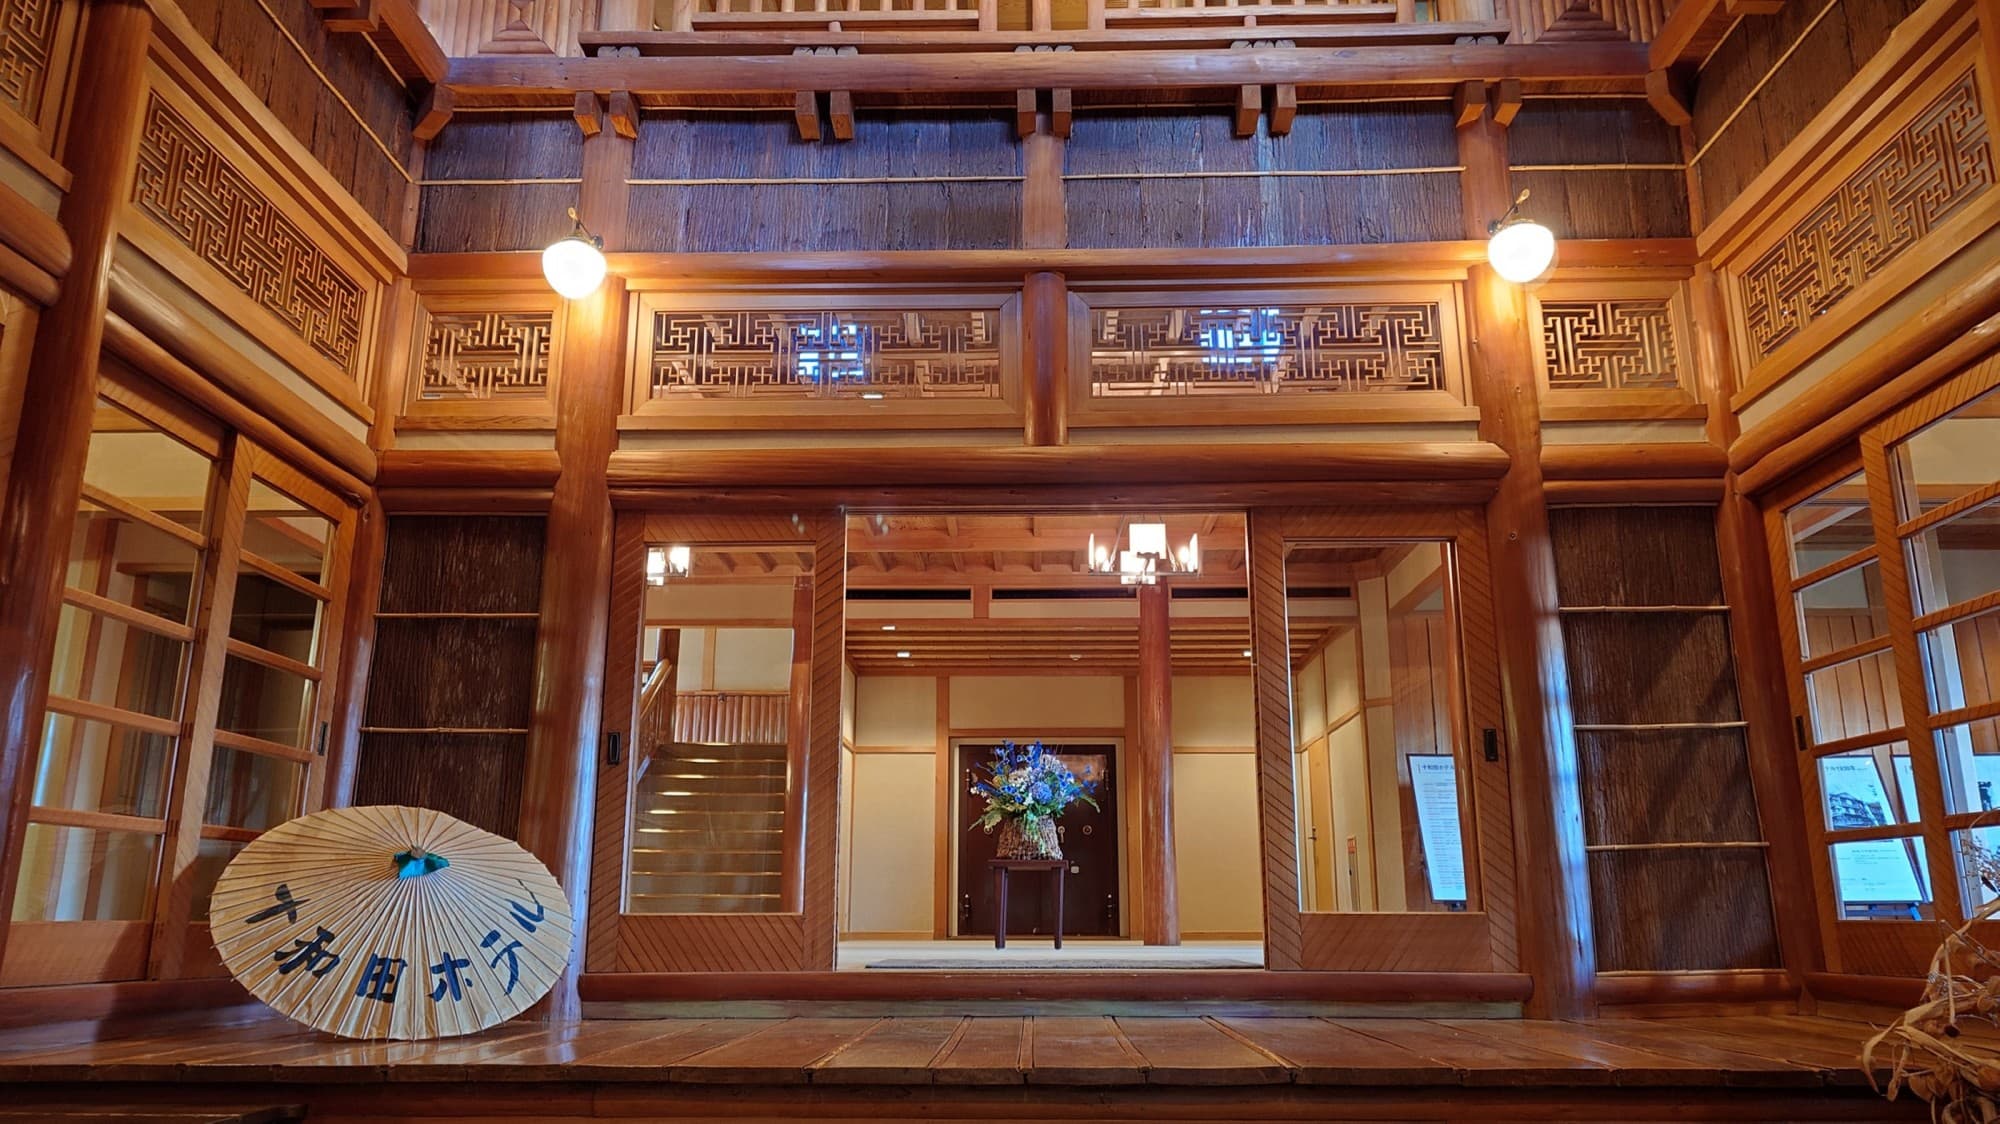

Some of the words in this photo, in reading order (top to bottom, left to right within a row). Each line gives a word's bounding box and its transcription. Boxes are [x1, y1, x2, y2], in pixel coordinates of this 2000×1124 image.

[245, 879, 545, 1003] 十和田ホテル
